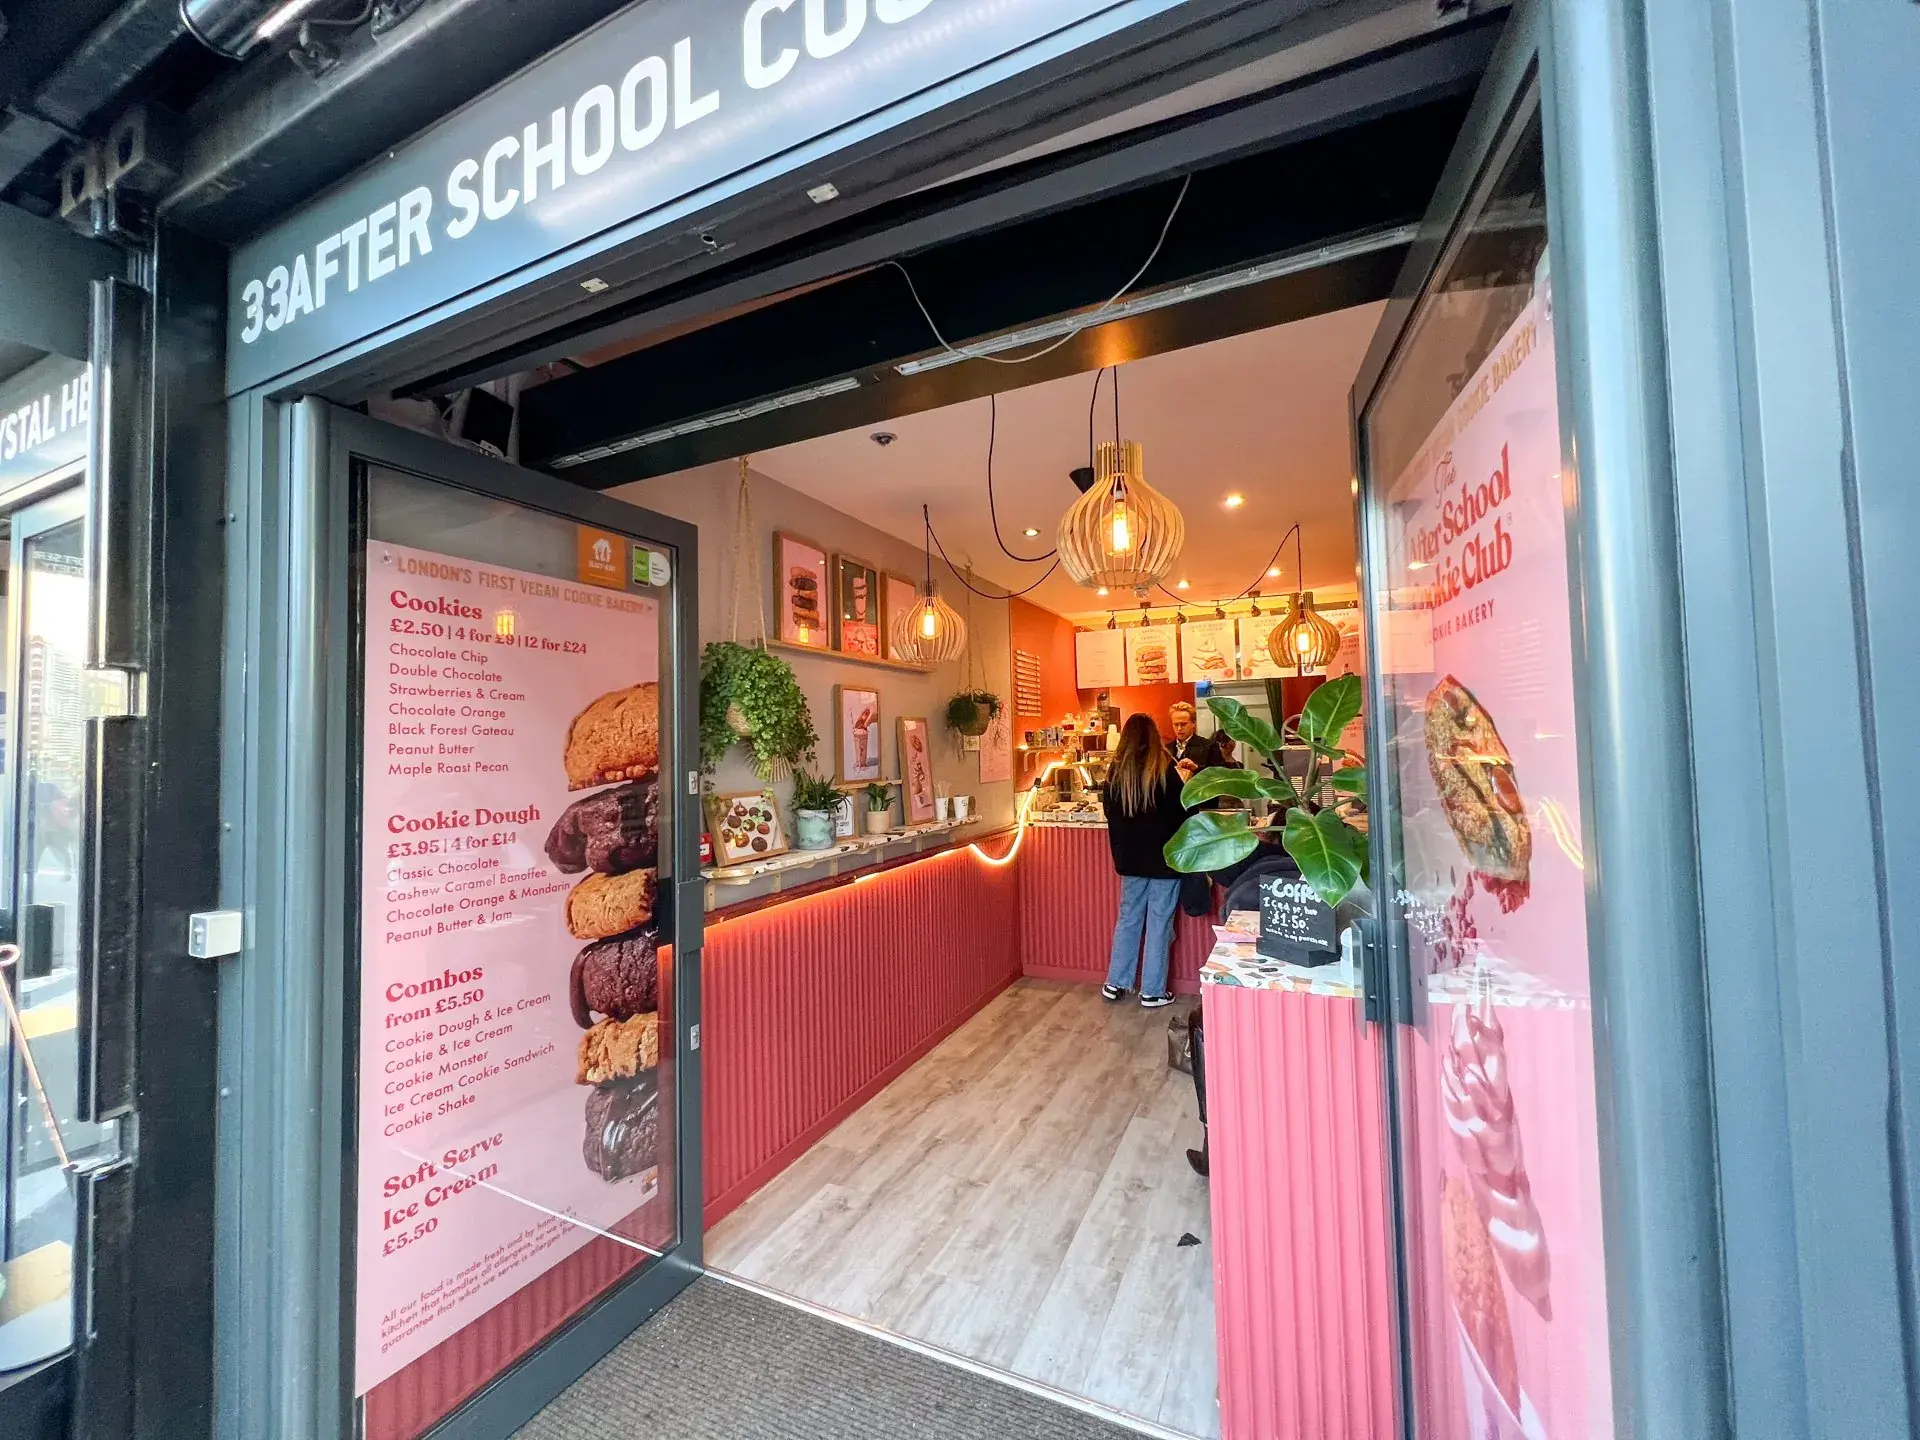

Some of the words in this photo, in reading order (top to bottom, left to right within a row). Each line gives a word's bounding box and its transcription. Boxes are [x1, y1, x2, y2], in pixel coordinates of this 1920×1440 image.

[446, 36, 720, 239] SCHOOL
[743, 0, 934, 89] CO
[1442, 440, 1512, 546] School
[1462, 515, 1513, 589] Club
[390, 590, 483, 619] Cookies
[397, 556, 473, 584] LONDON'S
[478, 571, 515, 592] FIRST
[520, 579, 559, 598] VEGAN
[564, 588, 602, 607] COOKIE
[606, 598, 644, 614] BAKERY
[1456, 597, 1495, 632] BAKERY
[389, 643, 457, 660] Chocolate
[461, 650, 488, 665] Chip
[390, 618, 444, 637] £2.50
[455, 627, 465, 640] 4
[469, 629, 492, 644] for
[524, 636, 538, 648] 12
[541, 638, 561, 651] for
[563, 641, 587, 654] £24
[389, 663, 438, 678] Double
[442, 666, 503, 682] Chocolate
[389, 682, 472, 699] Strawberries
[476, 688, 485, 699] &
[489, 689, 525, 701] Cream
[389, 702, 456, 716] Chocolate
[460, 705, 506, 720] Orange
[389, 723, 425, 735] Black
[430, 723, 467, 736] Forest
[472, 724, 515, 736] Gateau
[388, 743, 434, 755] Peanut
[439, 743, 474, 754] Butter
[388, 762, 432, 777] Maple
[437, 762, 471, 773] Roast
[475, 762, 509, 772] Pecan
[387, 810, 470, 834] Cookie
[475, 804, 541, 826] Dough
[387, 840, 440, 858] £3.95
[451, 837, 461, 850] 4
[466, 836, 489, 849] for
[491, 831, 516, 846] £14
[386, 886, 440, 902] Cashew
[445, 874, 496, 893] Caramel
[500, 867, 547, 883] Banoffee
[387, 867, 434, 882] Classic
[438, 858, 499, 875] Chocolate
[386, 903, 454, 923] Chocolate
[459, 893, 505, 910] Orange
[509, 889, 517, 900] &
[521, 882, 570, 898] Mandarin
[386, 926, 432, 944] Peanut
[437, 919, 473, 934] Butter
[477, 914, 486, 925] &
[490, 910, 513, 923] Jam
[385, 966, 483, 1003] Combos
[385, 1006, 431, 1029] from
[435, 988, 484, 1014] £5.50
[385, 1030, 433, 1053] Cookie
[439, 1014, 479, 1036] Dough
[484, 1010, 493, 1021] &
[497, 1006, 513, 1017] Ice
[517, 993, 551, 1010] Cream
[385, 1050, 433, 1074] Cookie
[439, 1044, 448, 1056] &
[453, 1039, 471, 1051] Ice
[475, 1024, 513, 1043] Cream
[384, 1071, 433, 1094] Cookie
[438, 1050, 488, 1076] Monster
[384, 1102, 404, 1117] Ice
[410, 1084, 453, 1106] Cream
[458, 1065, 500, 1087] Cookie
[504, 1041, 555, 1069] Sandwich
[384, 1111, 433, 1137] Cookie
[438, 1093, 475, 1116] Shake
[384, 1160, 438, 1198] Soft
[443, 1133, 503, 1169] Serve
[384, 1202, 419, 1231] Ice
[424, 1163, 498, 1207] Cream
[382, 1217, 438, 1257] £5.50
[382, 1309, 397, 1325] All
[400, 1300, 417, 1314] our
[420, 1281, 444, 1302] food
[446, 1277, 454, 1287] is
[456, 1261, 482, 1280] made
[484, 1246, 504, 1263] fresh
[508, 1232, 523, 1249] and
[381, 1310, 418, 1339] kitchen
[421, 1299, 440, 1317] that
[443, 1274, 478, 1301] handles
[481, 1263, 492, 1277] all
[381, 1315, 434, 1354] guarantee
[437, 1299, 456, 1316] that
[459, 1284, 481, 1303] what
[482, 1275, 495, 1287] we
[498, 1261, 520, 1277] serve
